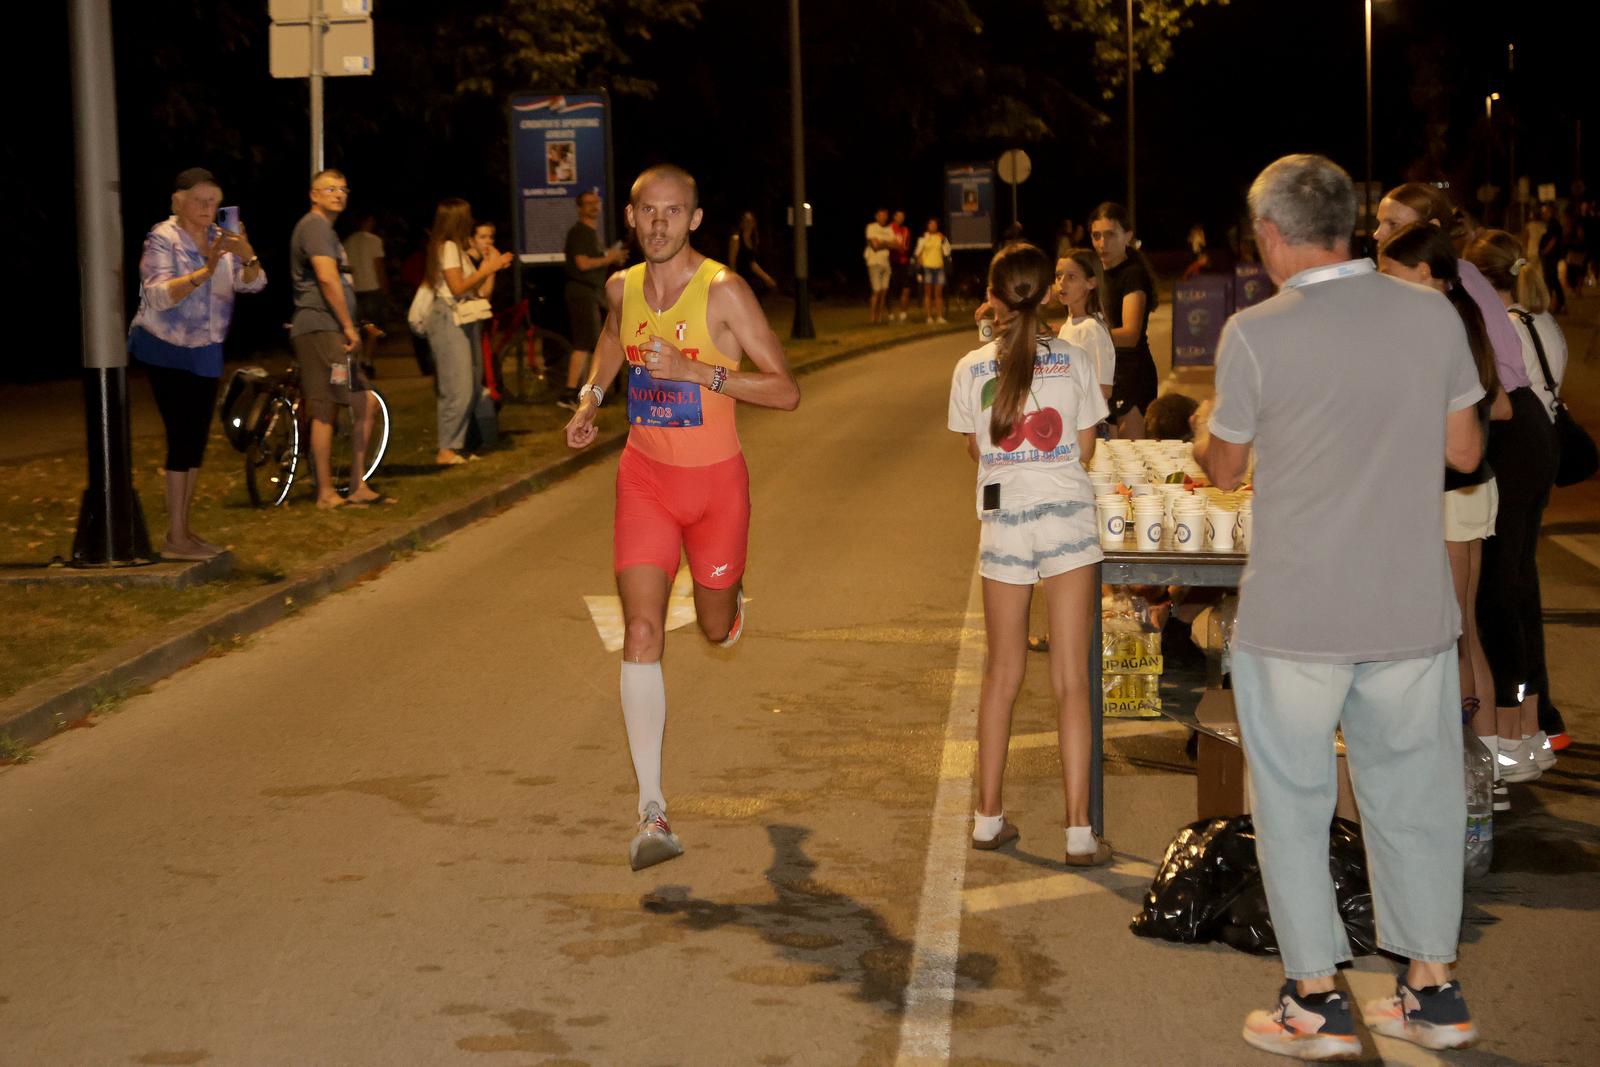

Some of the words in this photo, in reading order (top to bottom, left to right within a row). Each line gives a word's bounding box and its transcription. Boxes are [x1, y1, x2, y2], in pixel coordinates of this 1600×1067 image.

[970, 361, 985, 375] THE
[1033, 361, 1071, 375] arket
[630, 387, 698, 404] NOVOSEL
[996, 450, 1025, 462] SWEET
